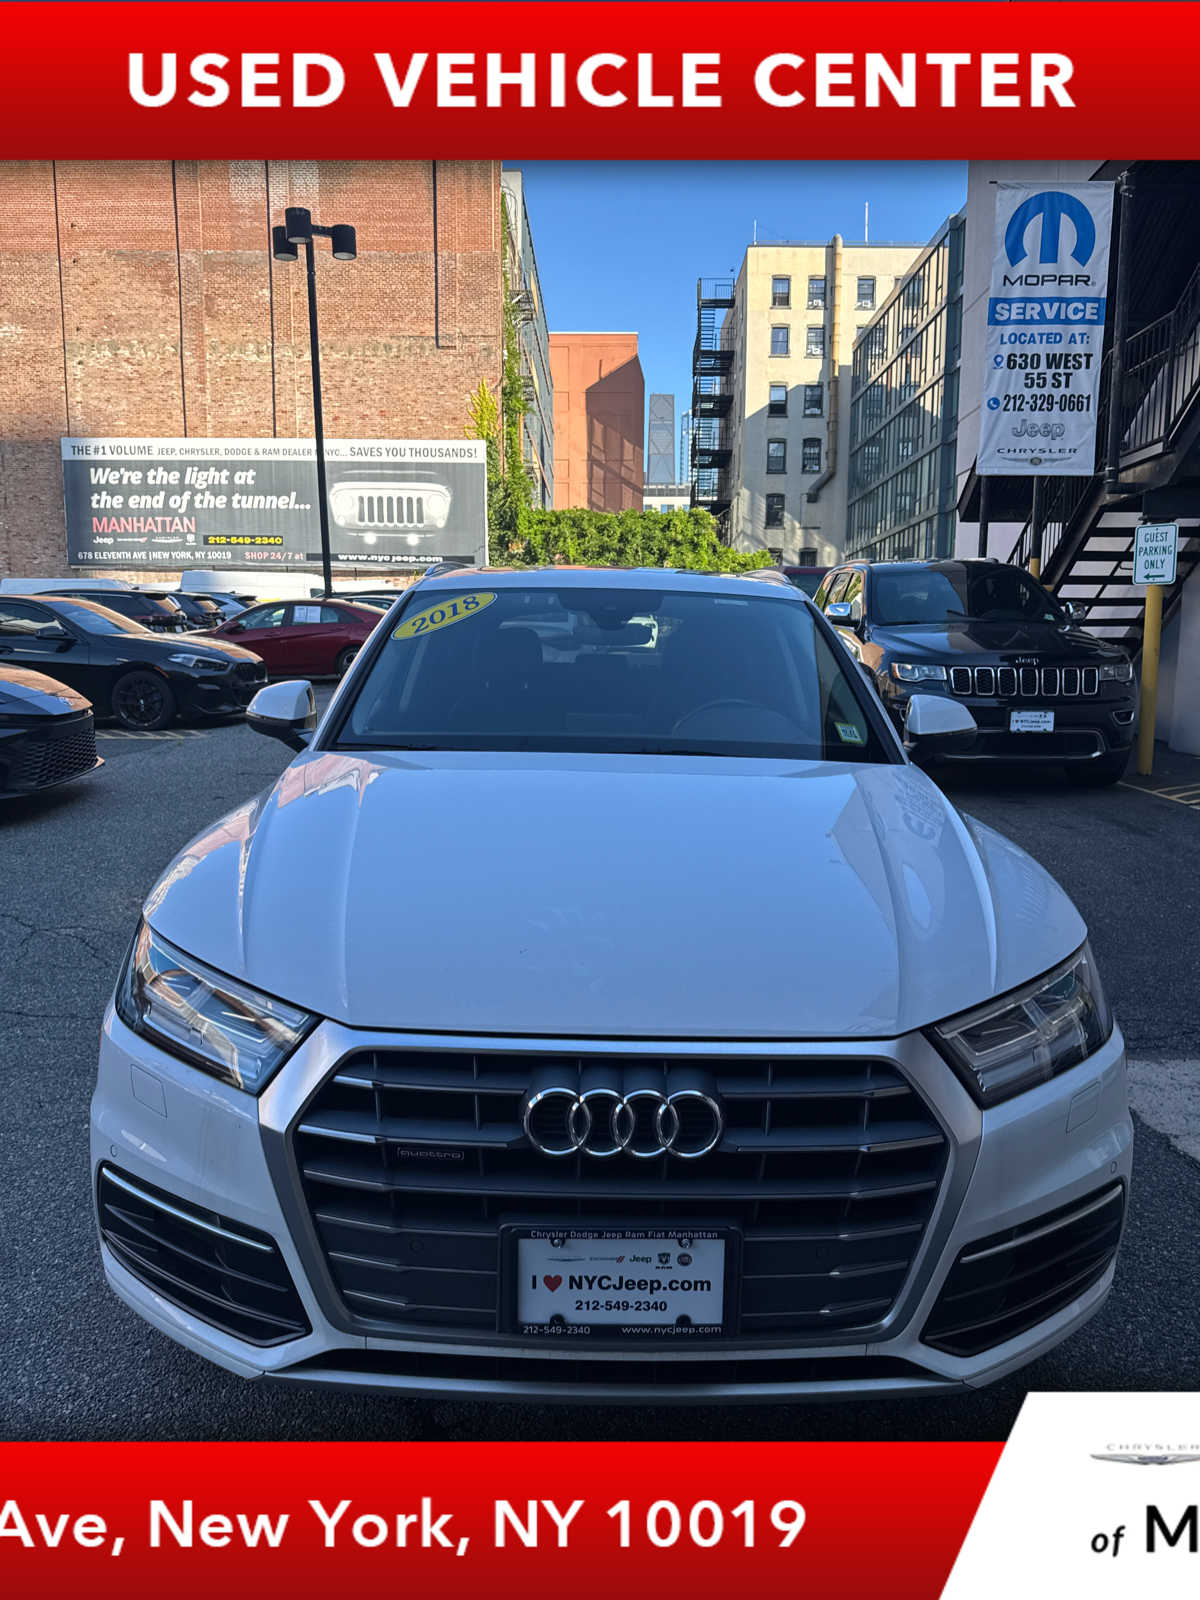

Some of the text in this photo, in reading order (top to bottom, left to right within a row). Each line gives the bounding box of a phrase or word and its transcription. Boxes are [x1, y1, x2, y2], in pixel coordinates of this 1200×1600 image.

[994, 302, 1099, 320] SERVICE
[1000, 332, 1090, 345] LOCATED AT:
[1006, 352, 1093, 370] 630 WEST
[1024, 372, 1073, 389] 55 ST
[1003, 394, 1091, 412] 212-329-0661
[1012, 419, 1065, 440] Jeep
[71, 445, 91, 456] THE
[93, 445, 106, 456] #1
[109, 445, 153, 456] VOLUME
[157, 448, 177, 457] JEEP,
[179, 448, 222, 457] CHRYSLER,
[262, 448, 280, 456] RAM
[282, 448, 312, 456] DEALER
[349, 447, 383, 457] SAVES
[384, 447, 407, 457] YOU
[408, 447, 478, 458] THOUSANDS!
[90, 467, 256, 489] We're the light at
[90, 491, 311, 513] the end of the tunnel...
[92, 516, 196, 533] MANHATTAN
[93, 535, 114, 545] Jeep
[1144, 531, 1168, 543] GUEST
[78, 551, 93, 560] 678
[94, 551, 132, 560] ELEVENTH
[132, 551, 147, 560] AVE
[170, 551, 194, 561] YORK,
[194, 551, 206, 560] NY
[207, 551, 231, 560] 10019
[245, 551, 304, 560] SHOP 24/7 at
[1138, 545, 1173, 556] PARKING
[1144, 558, 1165, 569] ONLY
[412, 596, 480, 634] 2018
[400, 1150, 461, 1160] quattro
[530, 1230, 718, 1240] Chrysler Dodge Jeep Ram Fiat Manhattan
[629, 1254, 652, 1264] Jeep
[531, 1275, 711, 1295] I NYCJeep.com
[575, 1300, 668, 1312] 212-549-2340
[522, 1325, 591, 1335] 212-549-2340
[621, 1325, 722, 1335] www.nycjeep.com
